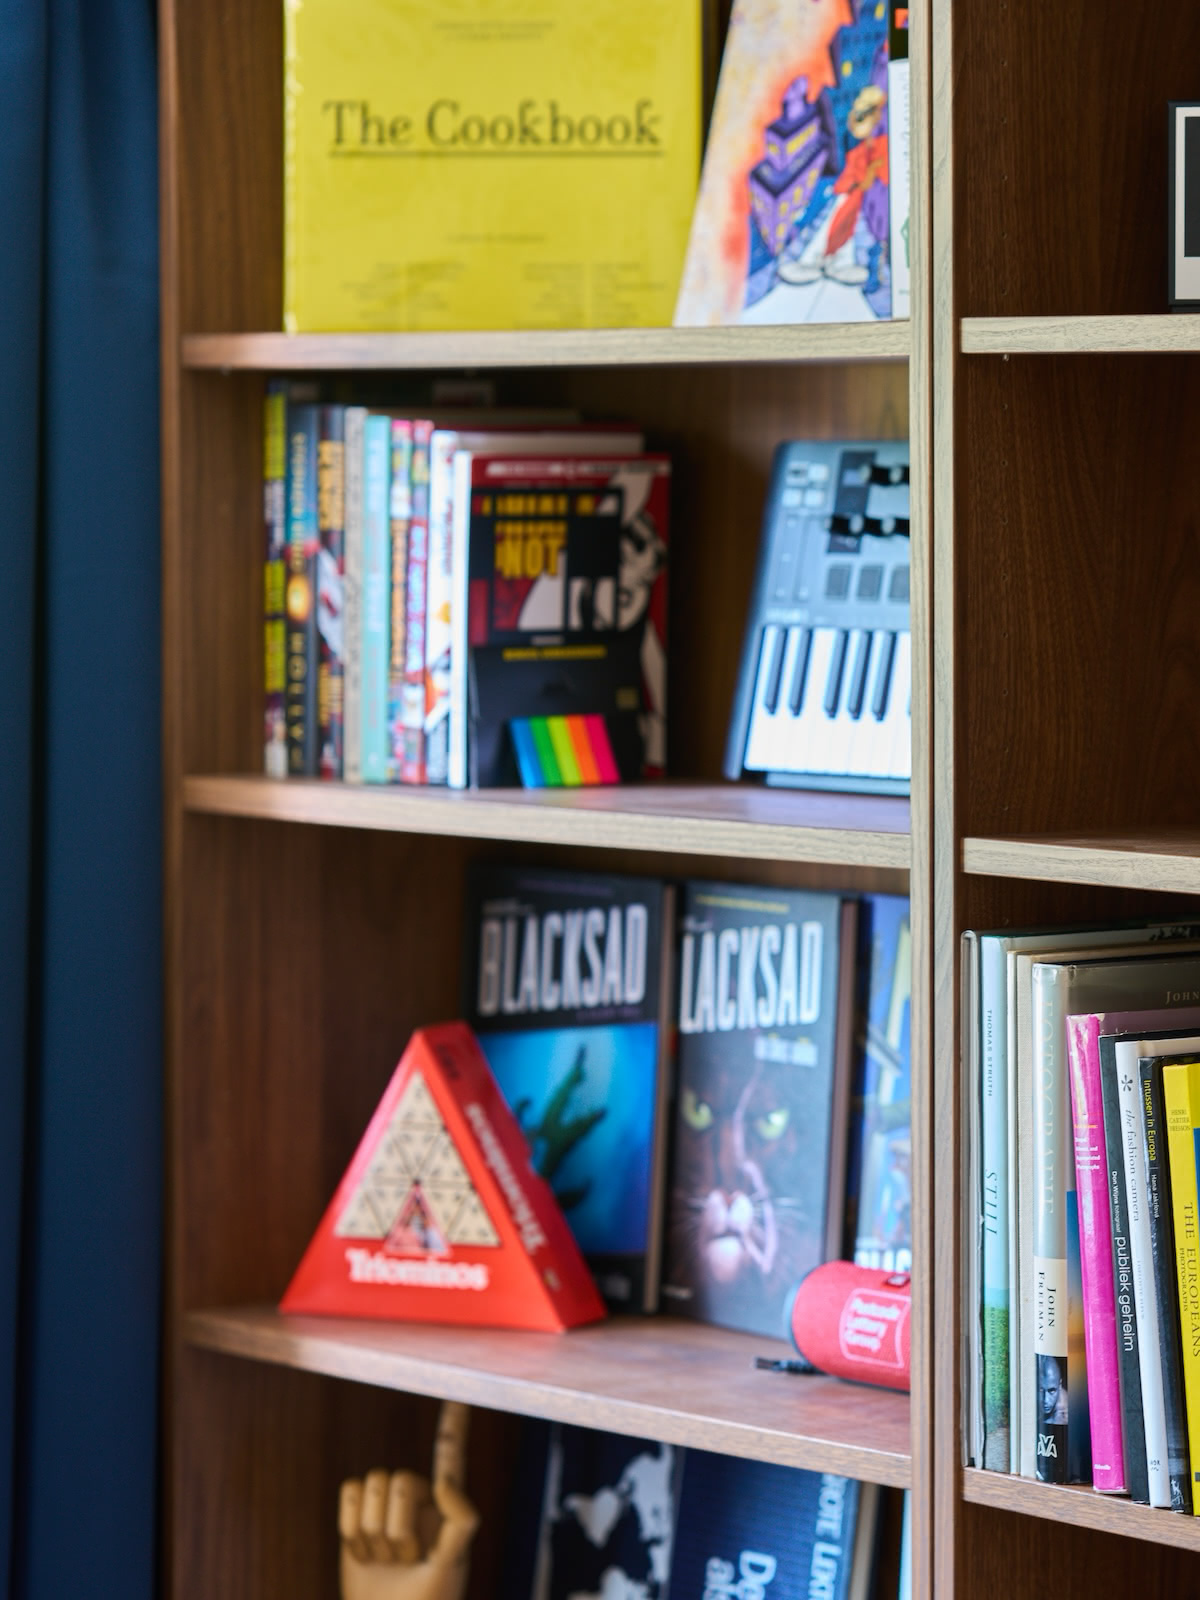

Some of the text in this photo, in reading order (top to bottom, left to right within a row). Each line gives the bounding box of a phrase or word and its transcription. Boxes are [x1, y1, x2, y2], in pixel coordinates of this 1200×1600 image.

[321, 98, 663, 147] The Cookbook
[477, 903, 648, 1017] BLACKSAD
[679, 920, 824, 1034] LACKSAD
[1165, 991, 1200, 1004] JOHN
[1143, 1079, 1157, 1161] Intussen in Europa
[1125, 1109, 1139, 1222] the fashion camera
[986, 1170, 998, 1236] STILL
[1184, 1201, 1195, 1239] THE
[345, 1248, 489, 1291] Triominos
[1114, 1236, 1134, 1352] publiek geheim
[1179, 1247, 1188, 1312] PHOTOGRAPHS
[1047, 1287, 1057, 1328] JOHN
